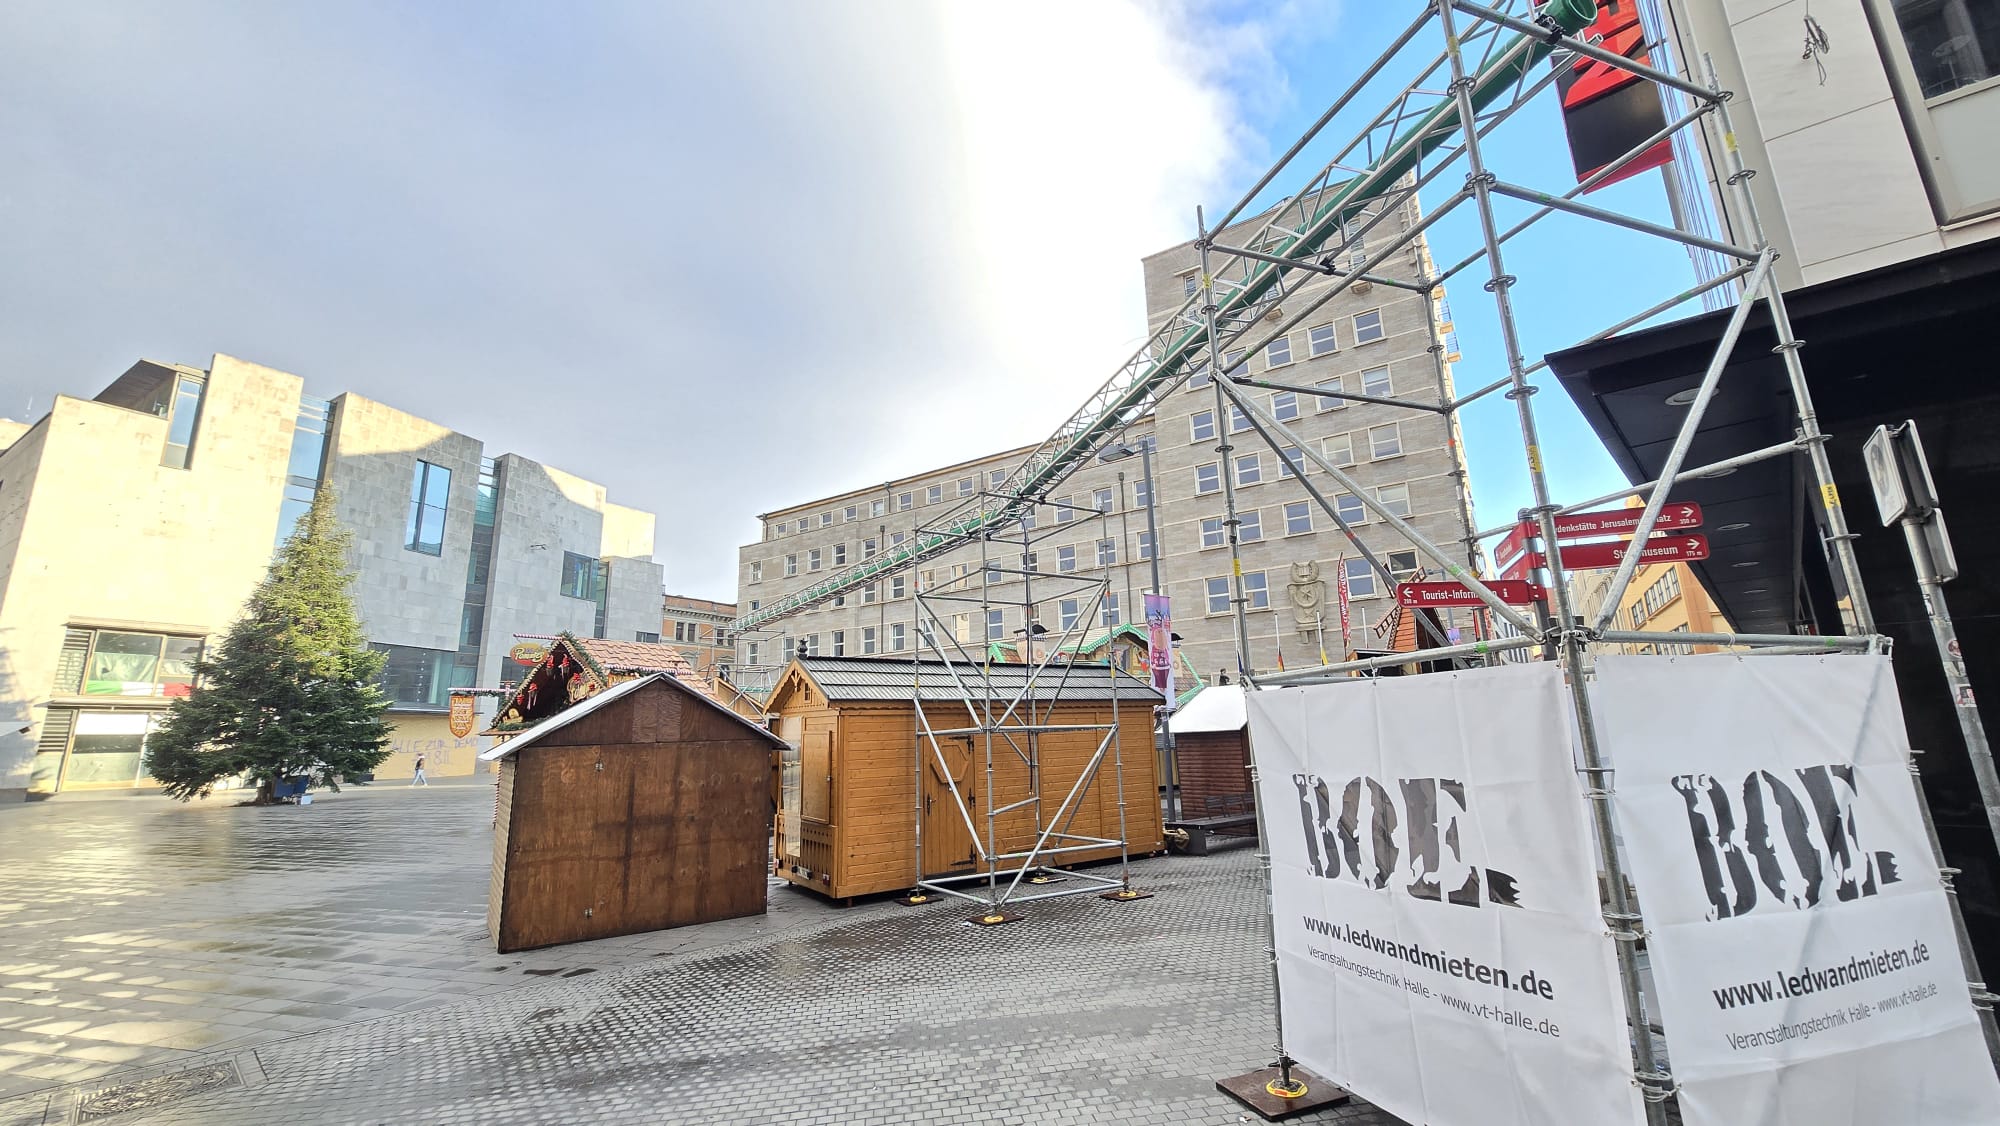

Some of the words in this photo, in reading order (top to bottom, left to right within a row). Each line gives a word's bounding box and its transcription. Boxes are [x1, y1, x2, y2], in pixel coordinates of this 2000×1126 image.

[1556, 522, 1597, 533] denkstätte
[1601, 517, 1641, 529] Jerusalem
[1613, 546, 1678, 559] Stamuseum
[1303, 915, 1554, 1000] www.ledwandmieten.de
[1307, 944, 1401, 988] Veranstaltungstechnik
[1403, 976, 1430, 998] Halle
[1440, 992, 1560, 1037] www.vt-halle.de
[1713, 940, 1930, 1010] www.ledwandmieten.de
[1726, 1008, 1848, 1051] Veranstaltungstechnik
[1848, 1003, 1871, 1023] Halle
[1877, 981, 1938, 1013] www.vt-halle.de
